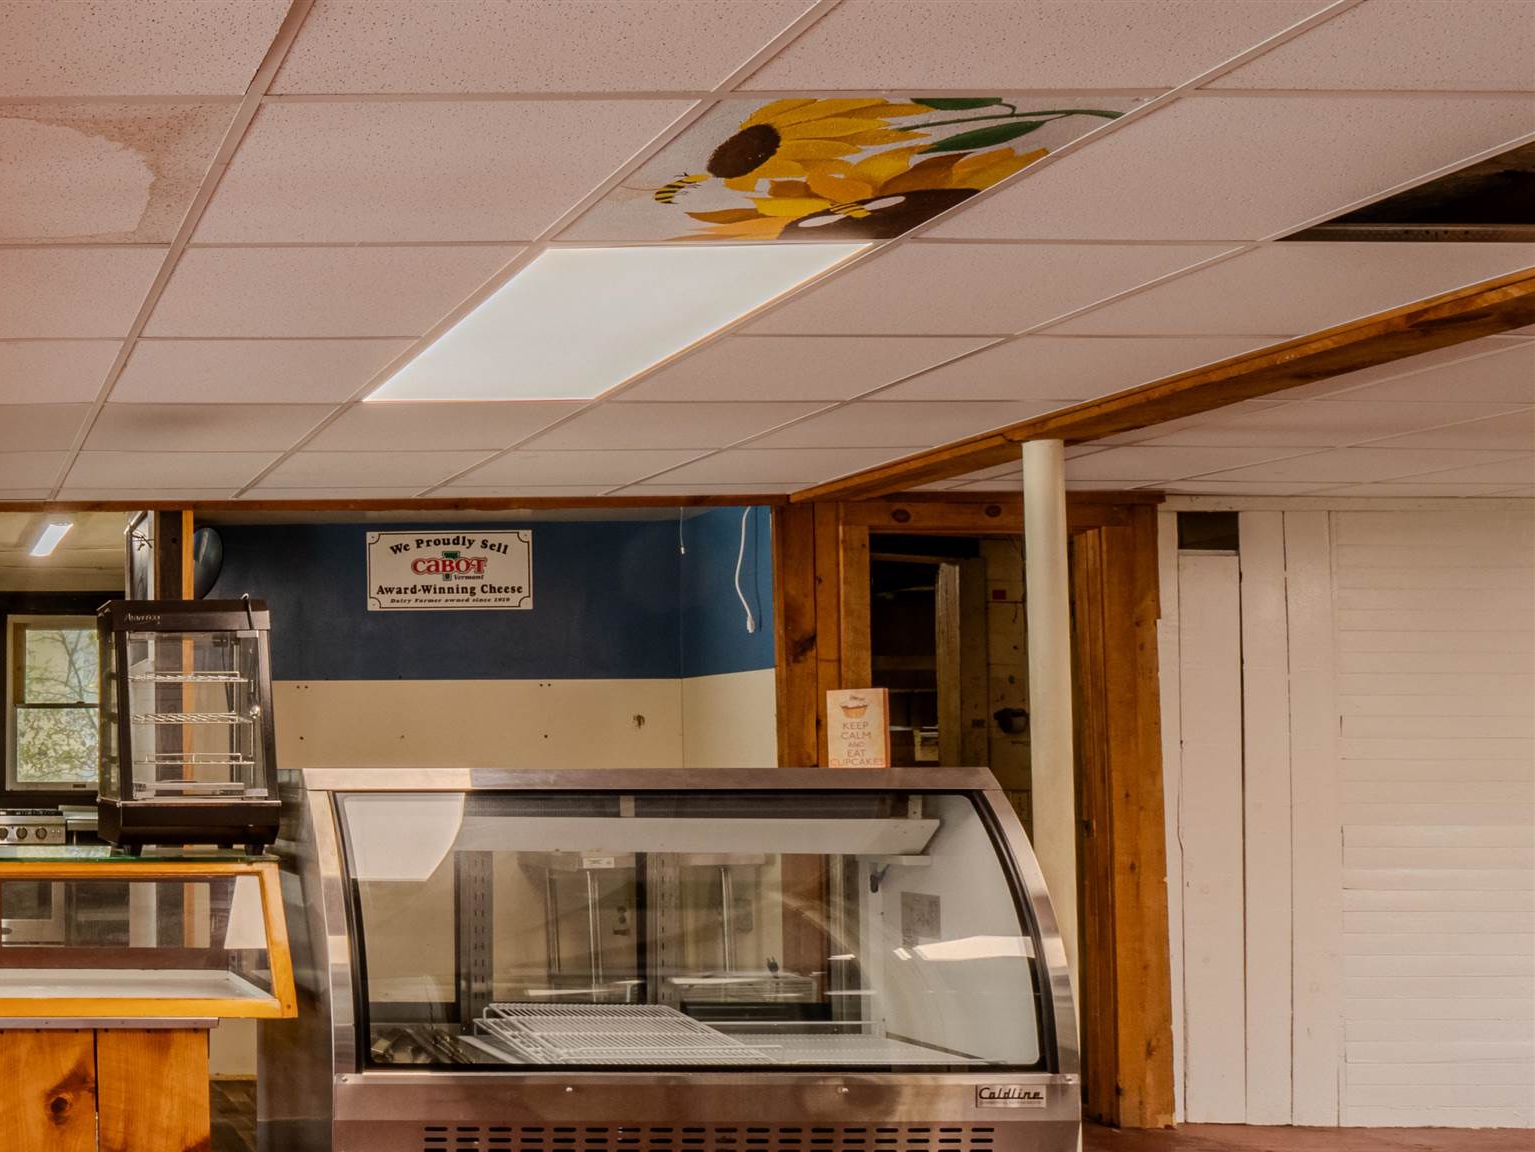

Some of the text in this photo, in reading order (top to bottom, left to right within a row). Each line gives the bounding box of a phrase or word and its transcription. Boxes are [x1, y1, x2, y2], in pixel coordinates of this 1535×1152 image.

[390, 536, 508, 555] We Proudly Sell
[377, 584, 523, 597] Award-Winning Cheese
[842, 722, 869, 730] KEEP
[841, 731, 872, 740] CALM
[847, 749, 866, 757] EAT
